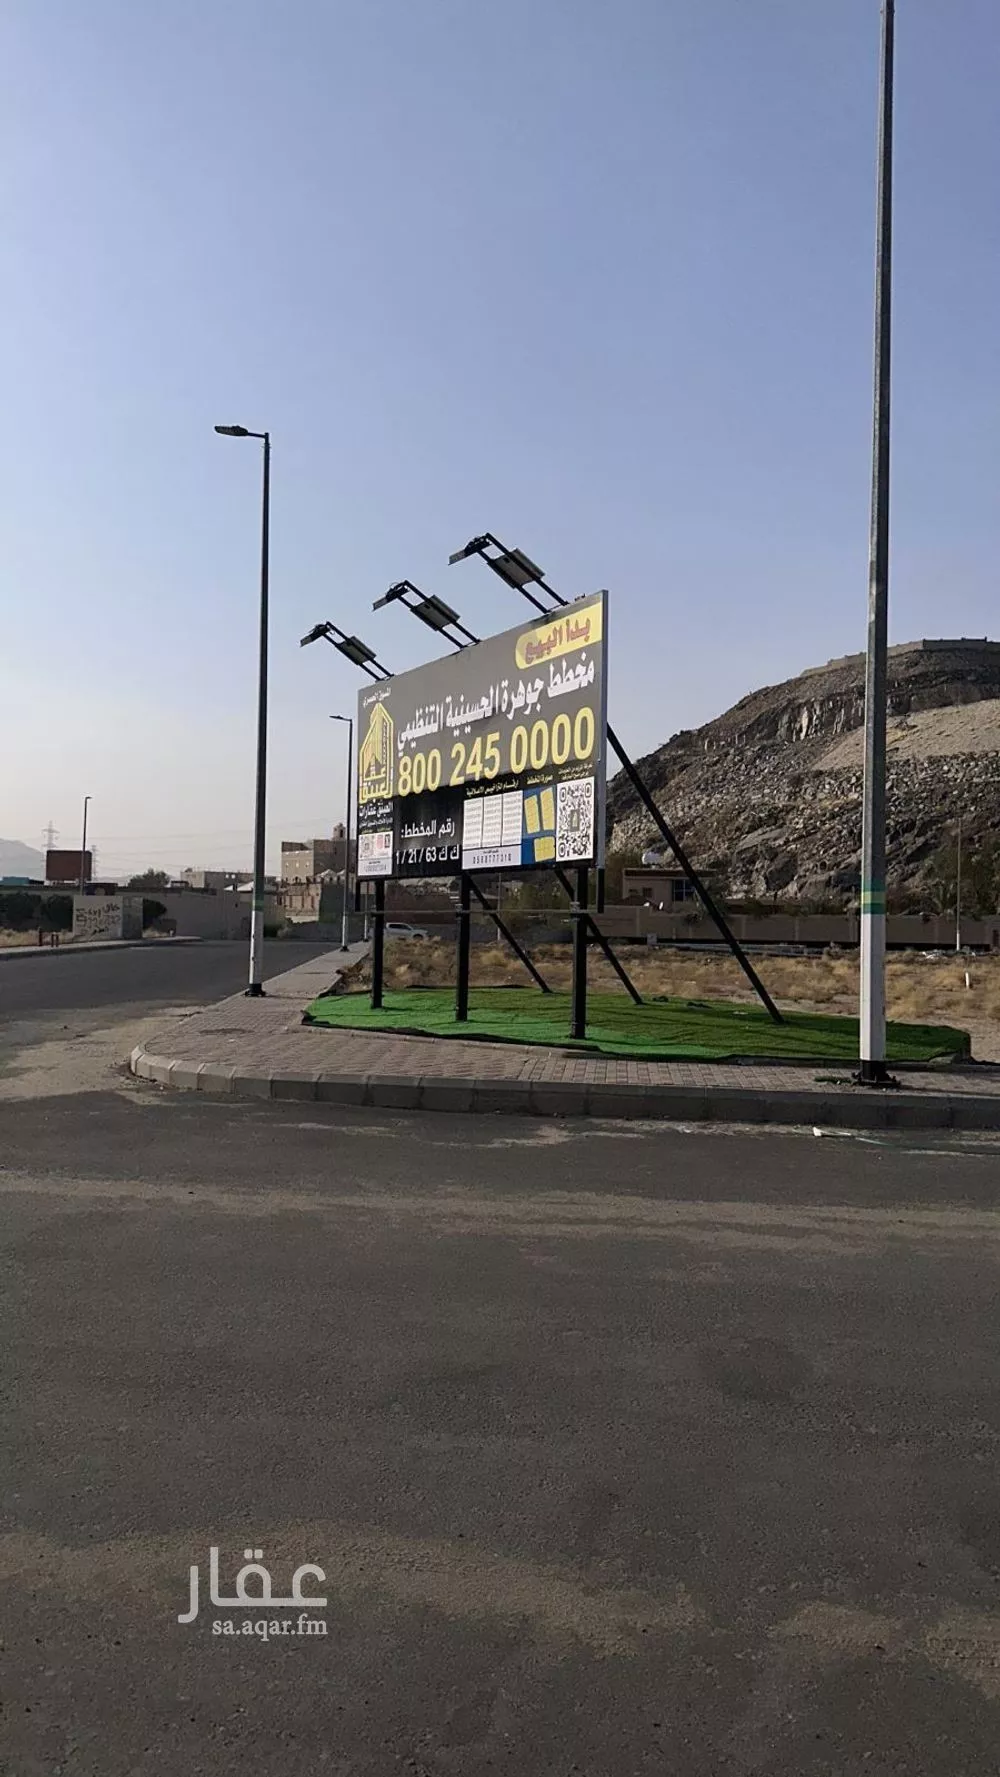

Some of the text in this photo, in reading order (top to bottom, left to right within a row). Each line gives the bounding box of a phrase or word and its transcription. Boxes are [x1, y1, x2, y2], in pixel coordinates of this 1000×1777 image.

[524, 617, 592, 664] بدأ البيع
[547, 652, 595, 698] مخطط
[446, 684, 500, 736] الحسينية
[501, 678, 544, 720] جوهرة
[397, 702, 444, 757] التنظيمي
[398, 748, 442, 797] 800
[450, 732, 501, 787] 245
[510, 707, 595, 774] 0000
[401, 820, 437, 838] المخطط:
[438, 818, 455, 838] رقم
